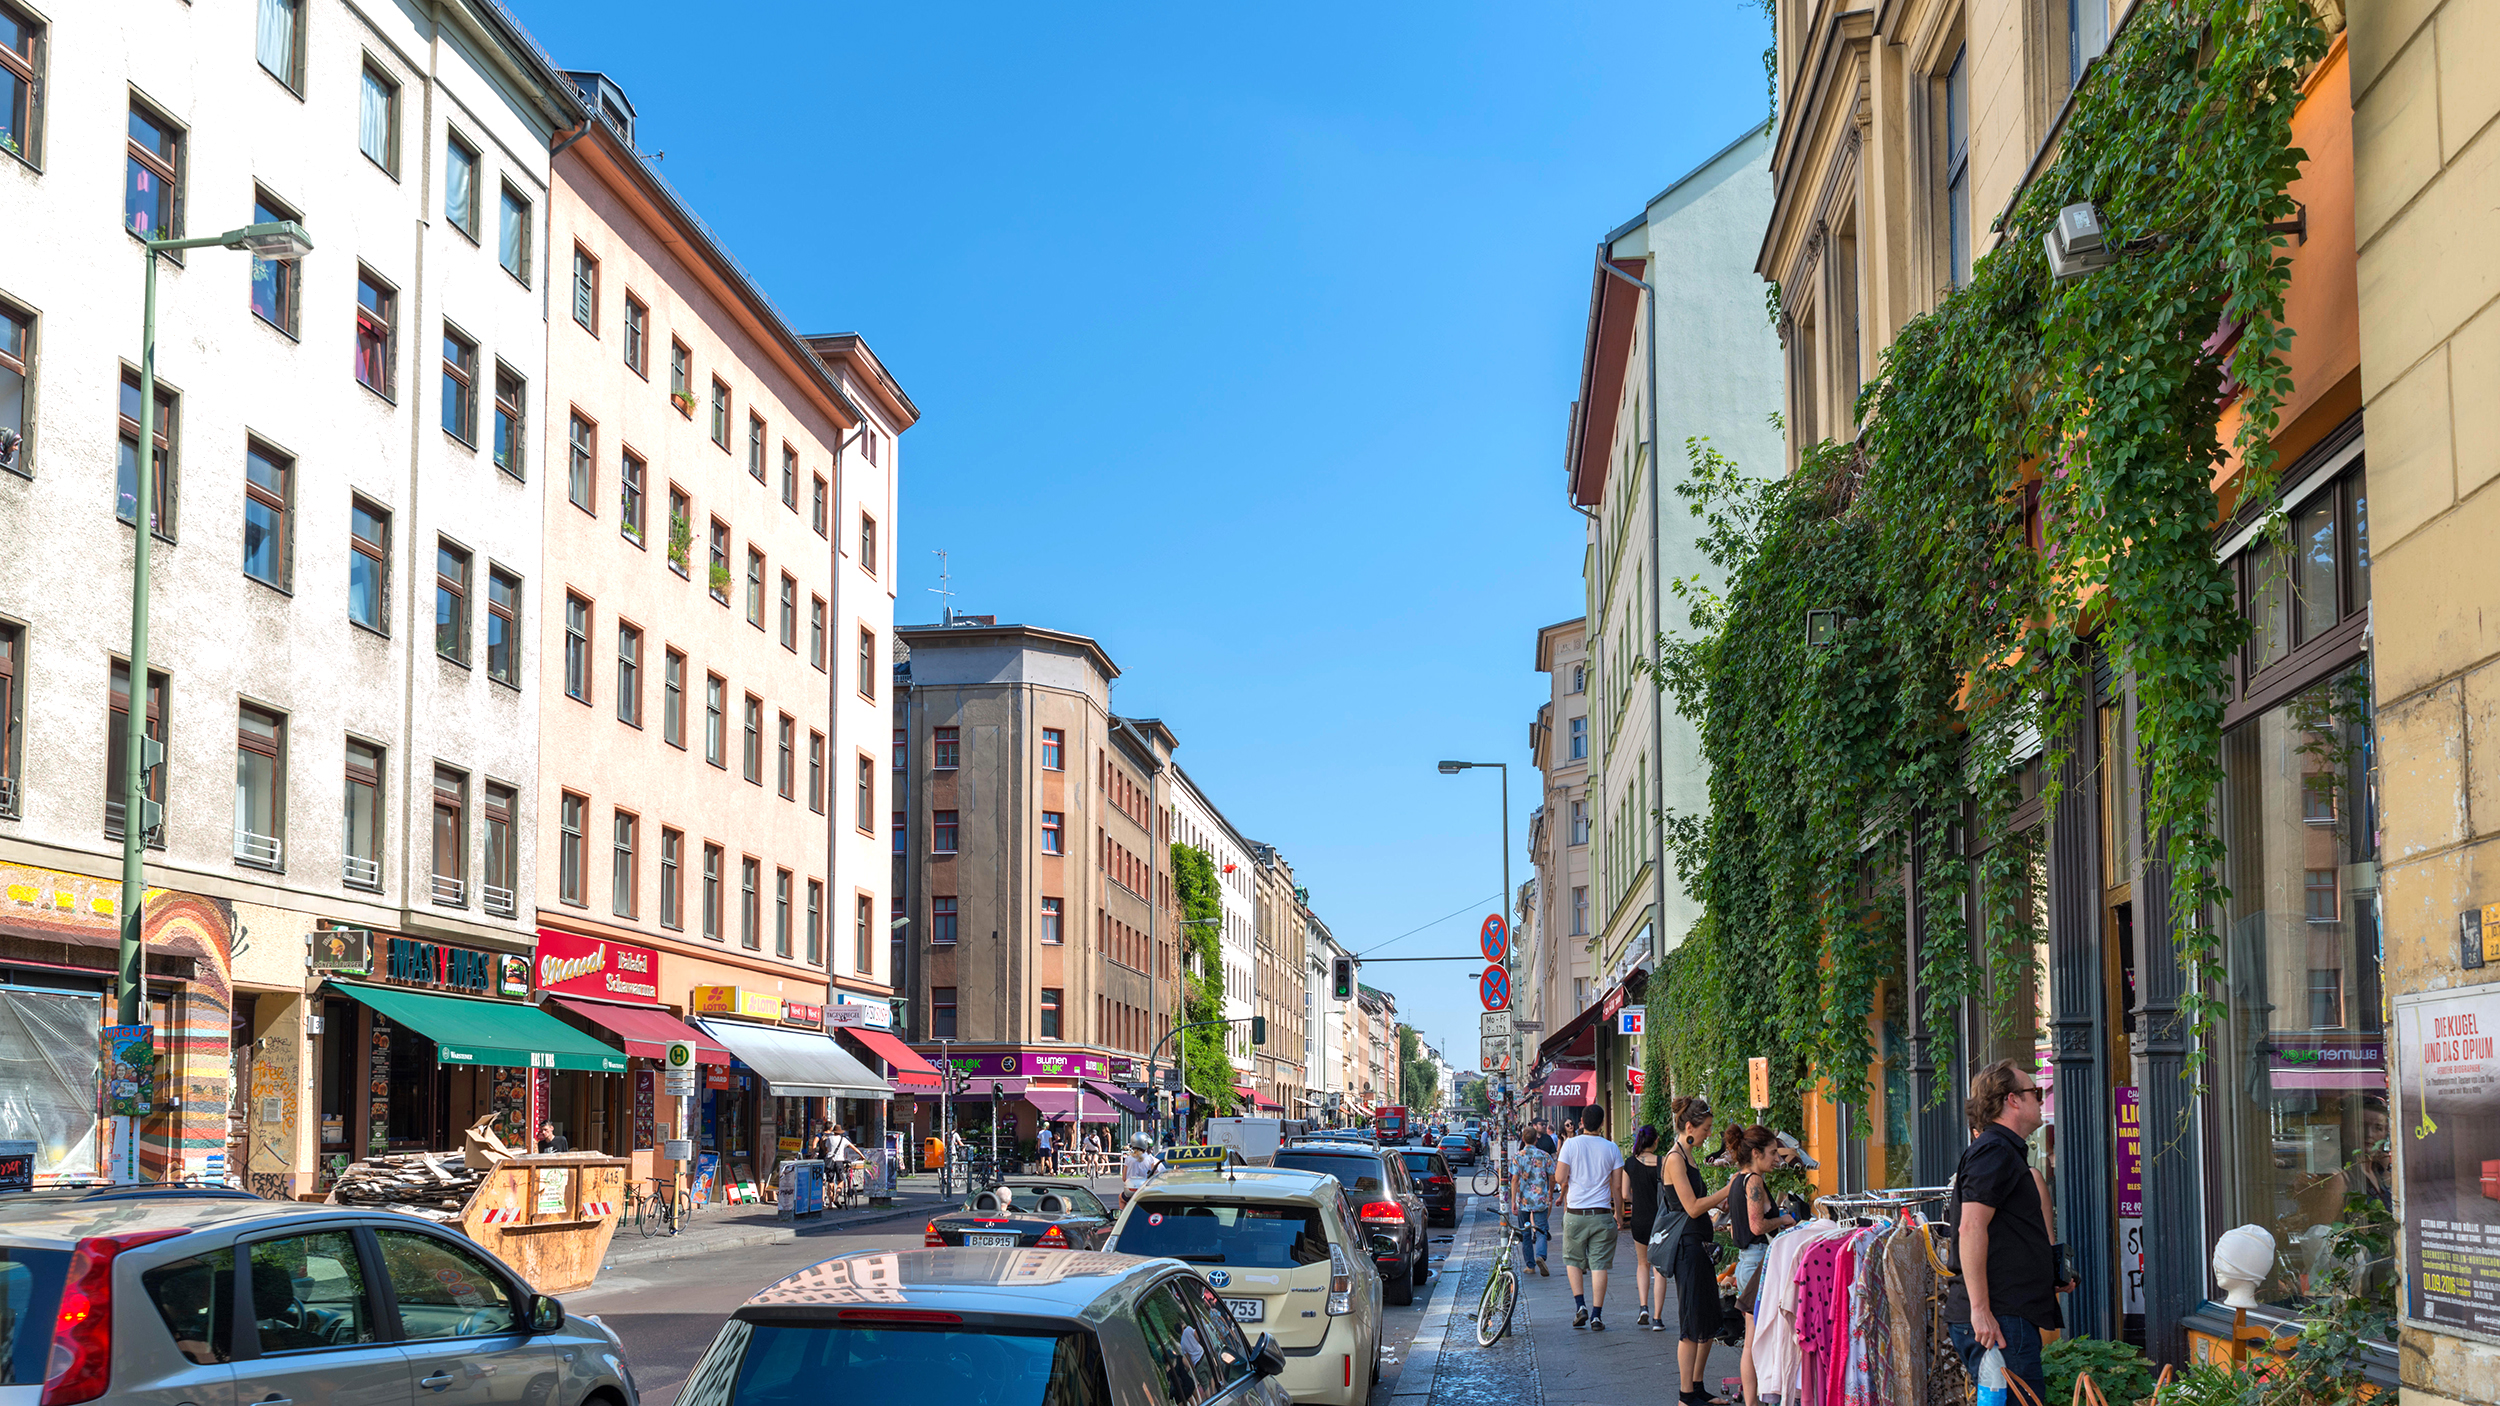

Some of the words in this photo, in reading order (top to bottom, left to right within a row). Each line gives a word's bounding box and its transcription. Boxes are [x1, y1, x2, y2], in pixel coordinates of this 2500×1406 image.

[388, 938, 434, 983] MAS
[437, 945, 450, 985] Y
[451, 948, 490, 990] MAS
[757, 998, 778, 1015] LOTTO
[826, 1011, 860, 1019] TAGESSPIEGEL
[2424, 1042, 2441, 1063] UND
[2442, 1040, 2460, 1062] DAS
[2462, 1037, 2493, 1060] OPIUM
[1548, 1085, 1581, 1096] HASIR
[1174, 1147, 1214, 1159] TAXI
[604, 1171, 619, 1184] 415
[972, 1237, 978, 1245] B
[982, 1237, 993, 1246] CB
[995, 1238, 1011, 1247] 915
[2423, 1273, 2456, 1294] 01.09.2016
